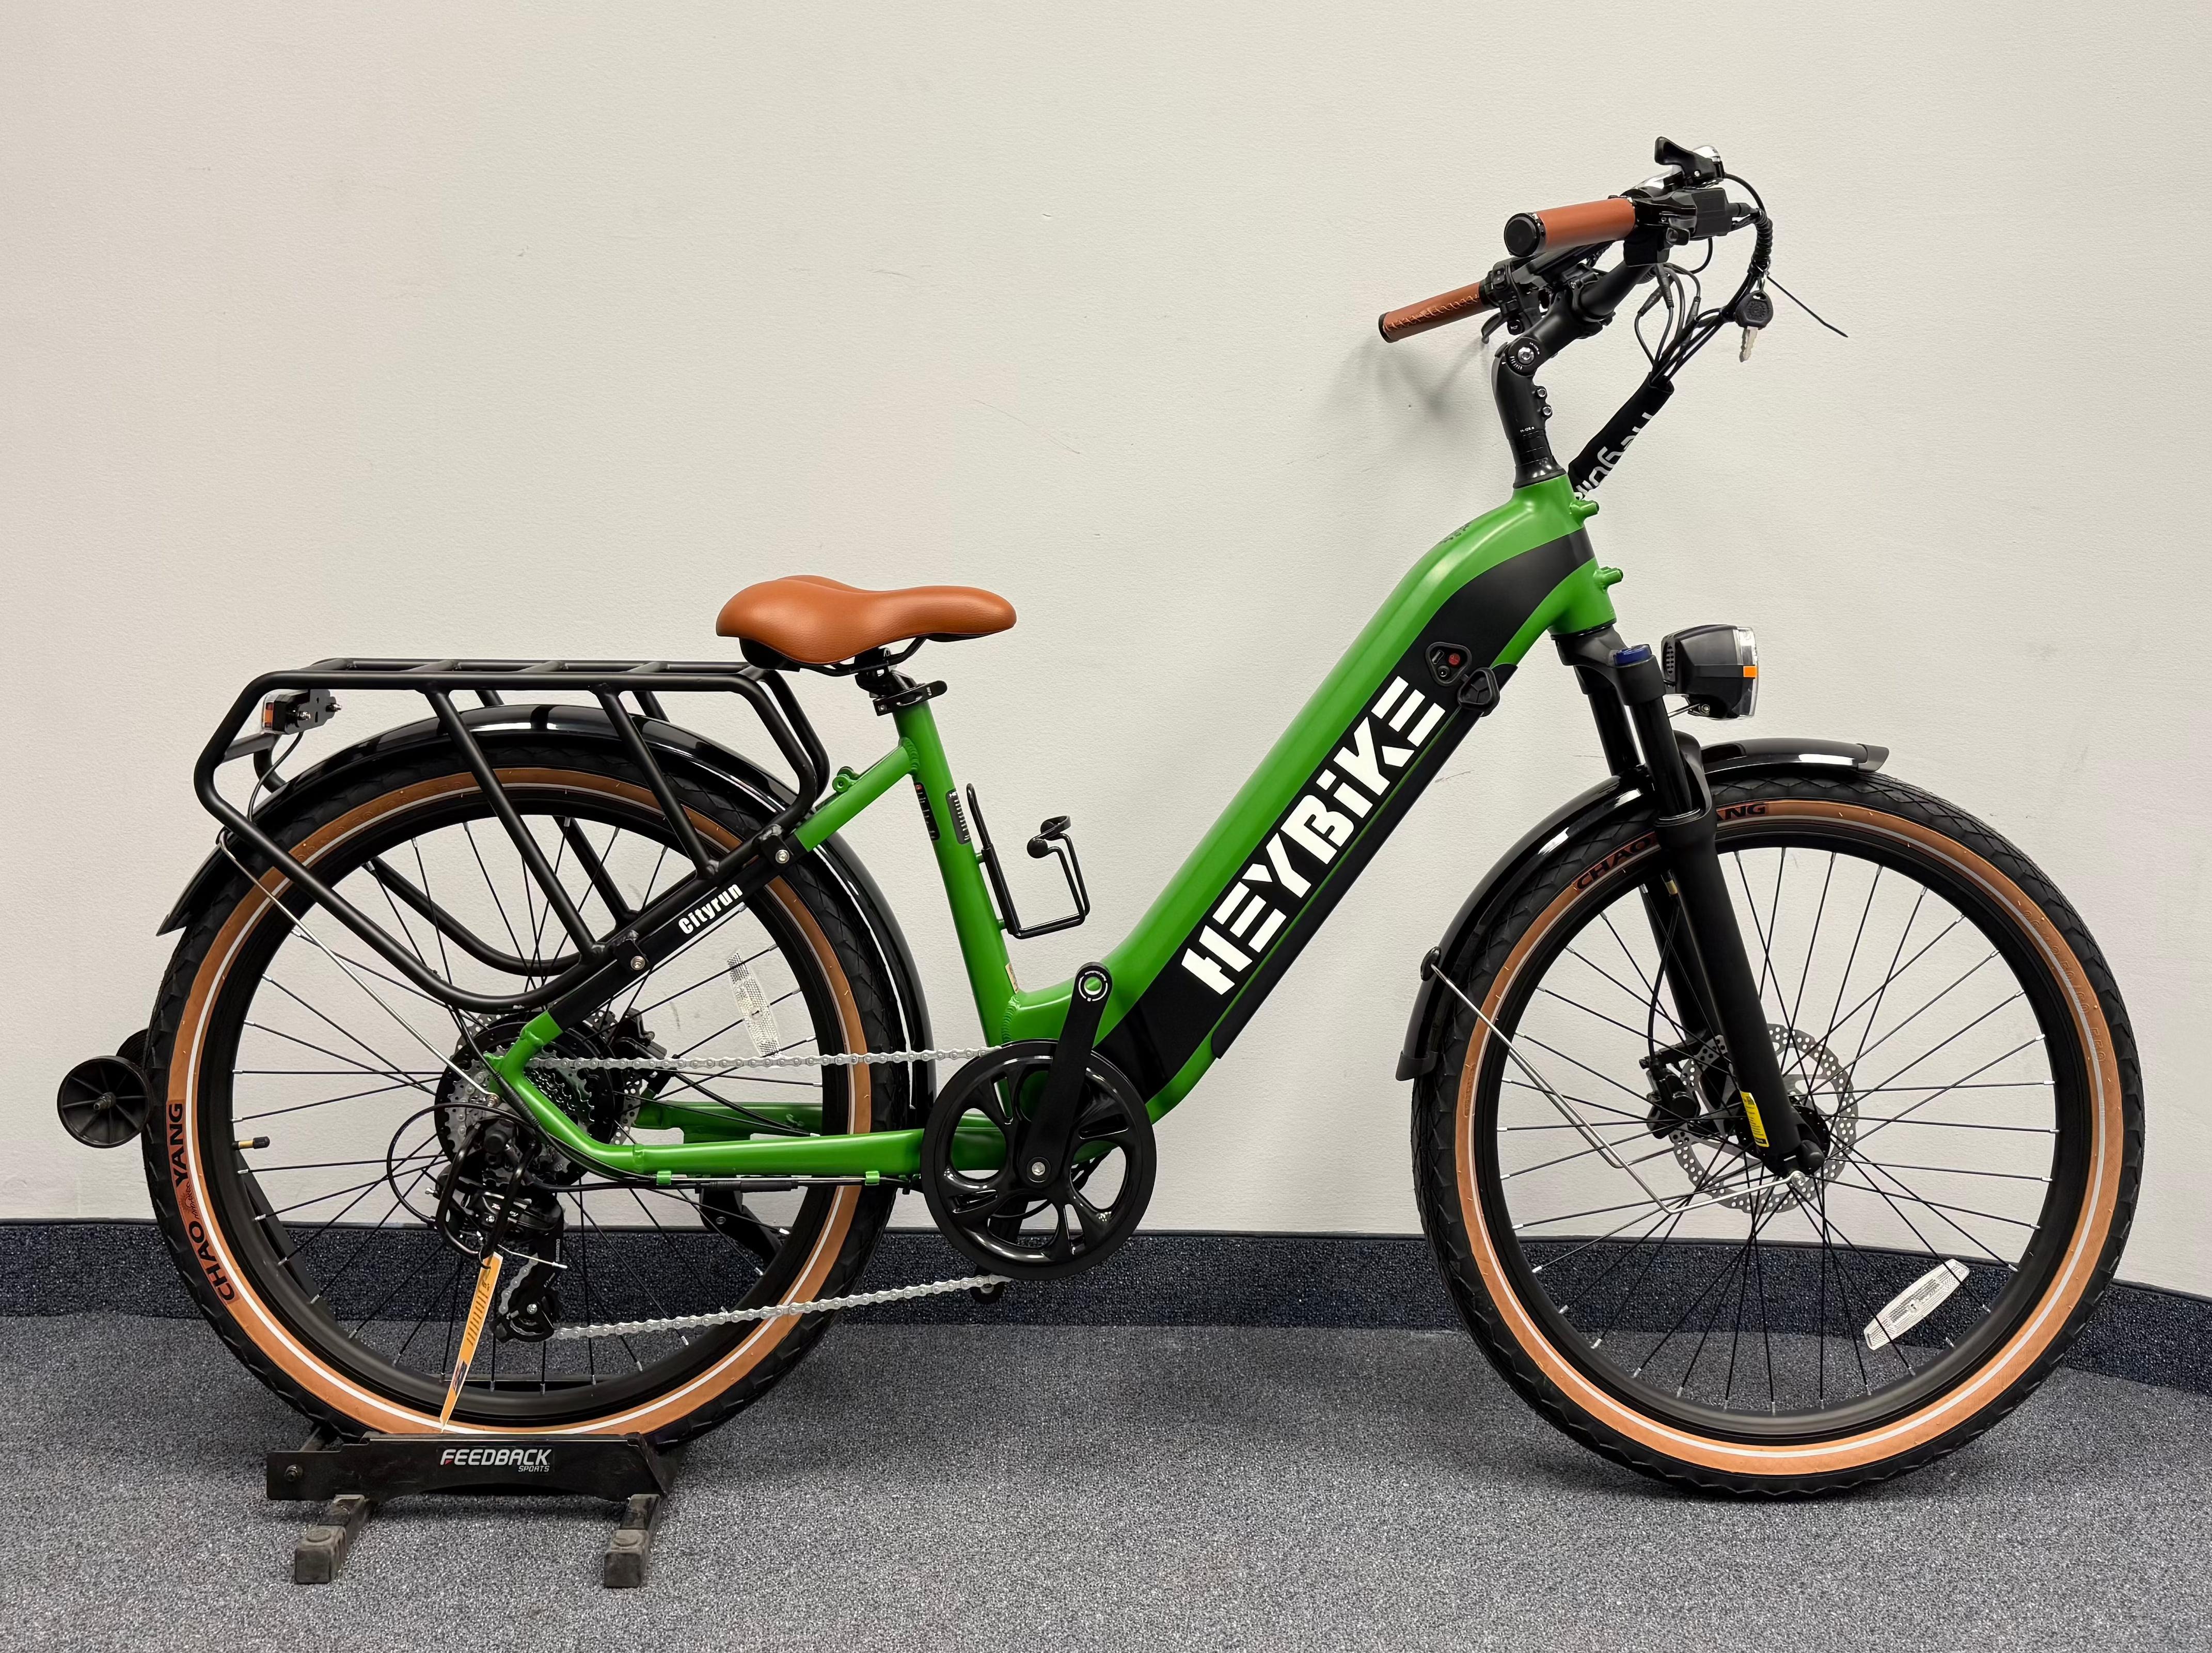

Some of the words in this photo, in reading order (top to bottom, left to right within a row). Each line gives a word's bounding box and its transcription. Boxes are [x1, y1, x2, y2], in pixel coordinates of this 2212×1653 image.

[1577, 837, 1651, 889] CHAO
[678, 884, 743, 934] Cityrun
[168, 1103, 188, 1187] YANG
[188, 1220, 235, 1301] CHAO
[440, 1449, 552, 1466] FEEDBACK
